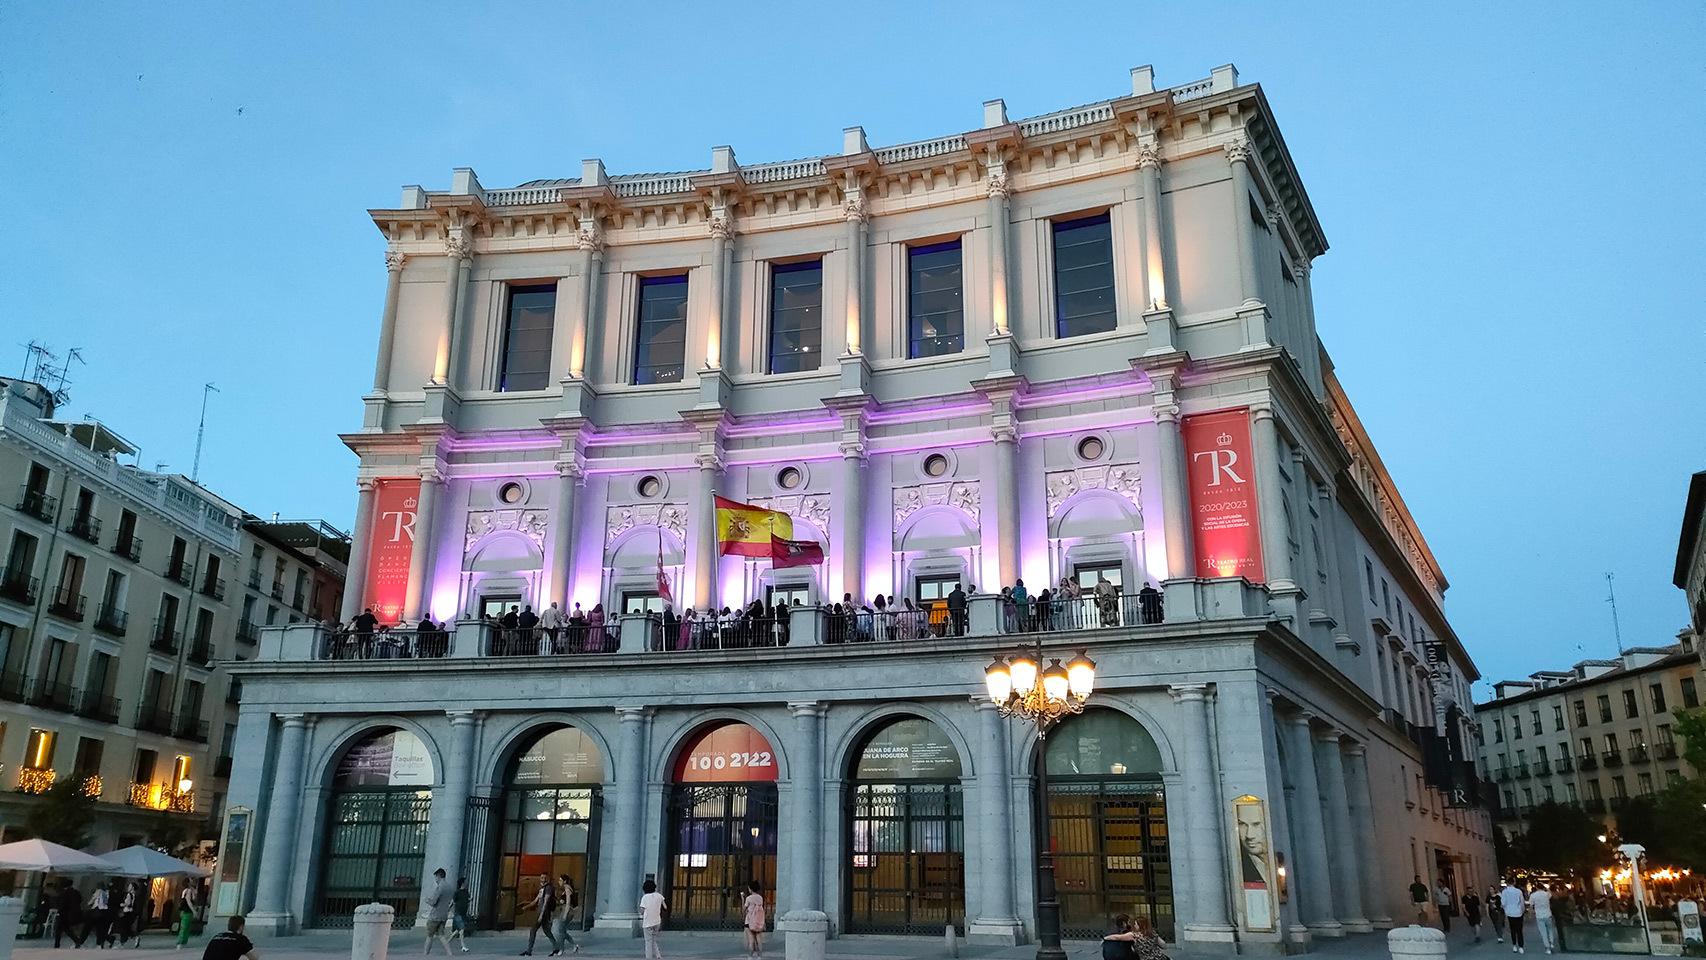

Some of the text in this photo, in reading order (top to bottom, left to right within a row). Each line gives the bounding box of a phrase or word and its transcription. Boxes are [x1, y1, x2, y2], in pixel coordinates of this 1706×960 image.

[1194, 449, 1247, 487] TR
[1200, 500, 1247, 512] 2020/2023
[690, 756, 726, 770] 100
